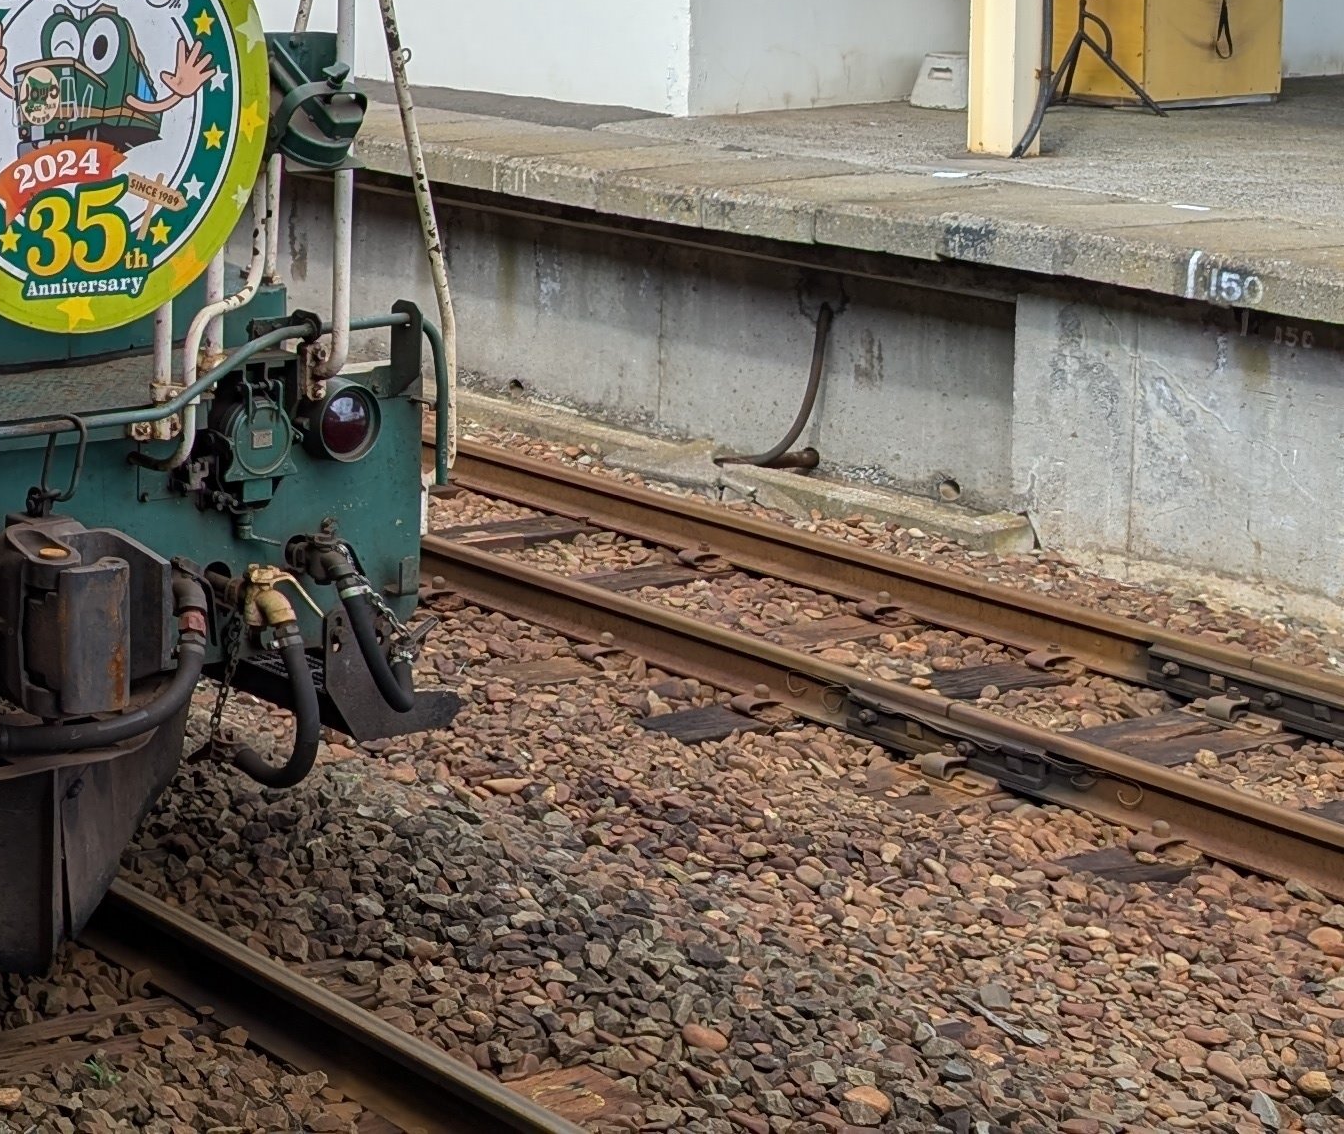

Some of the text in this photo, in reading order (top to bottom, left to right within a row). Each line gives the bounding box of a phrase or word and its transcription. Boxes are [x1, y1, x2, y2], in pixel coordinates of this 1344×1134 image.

[13, 147, 101, 194] 2024
[129, 177, 180, 207] SINCE 1989
[26, 275, 144, 298] Anniversary
